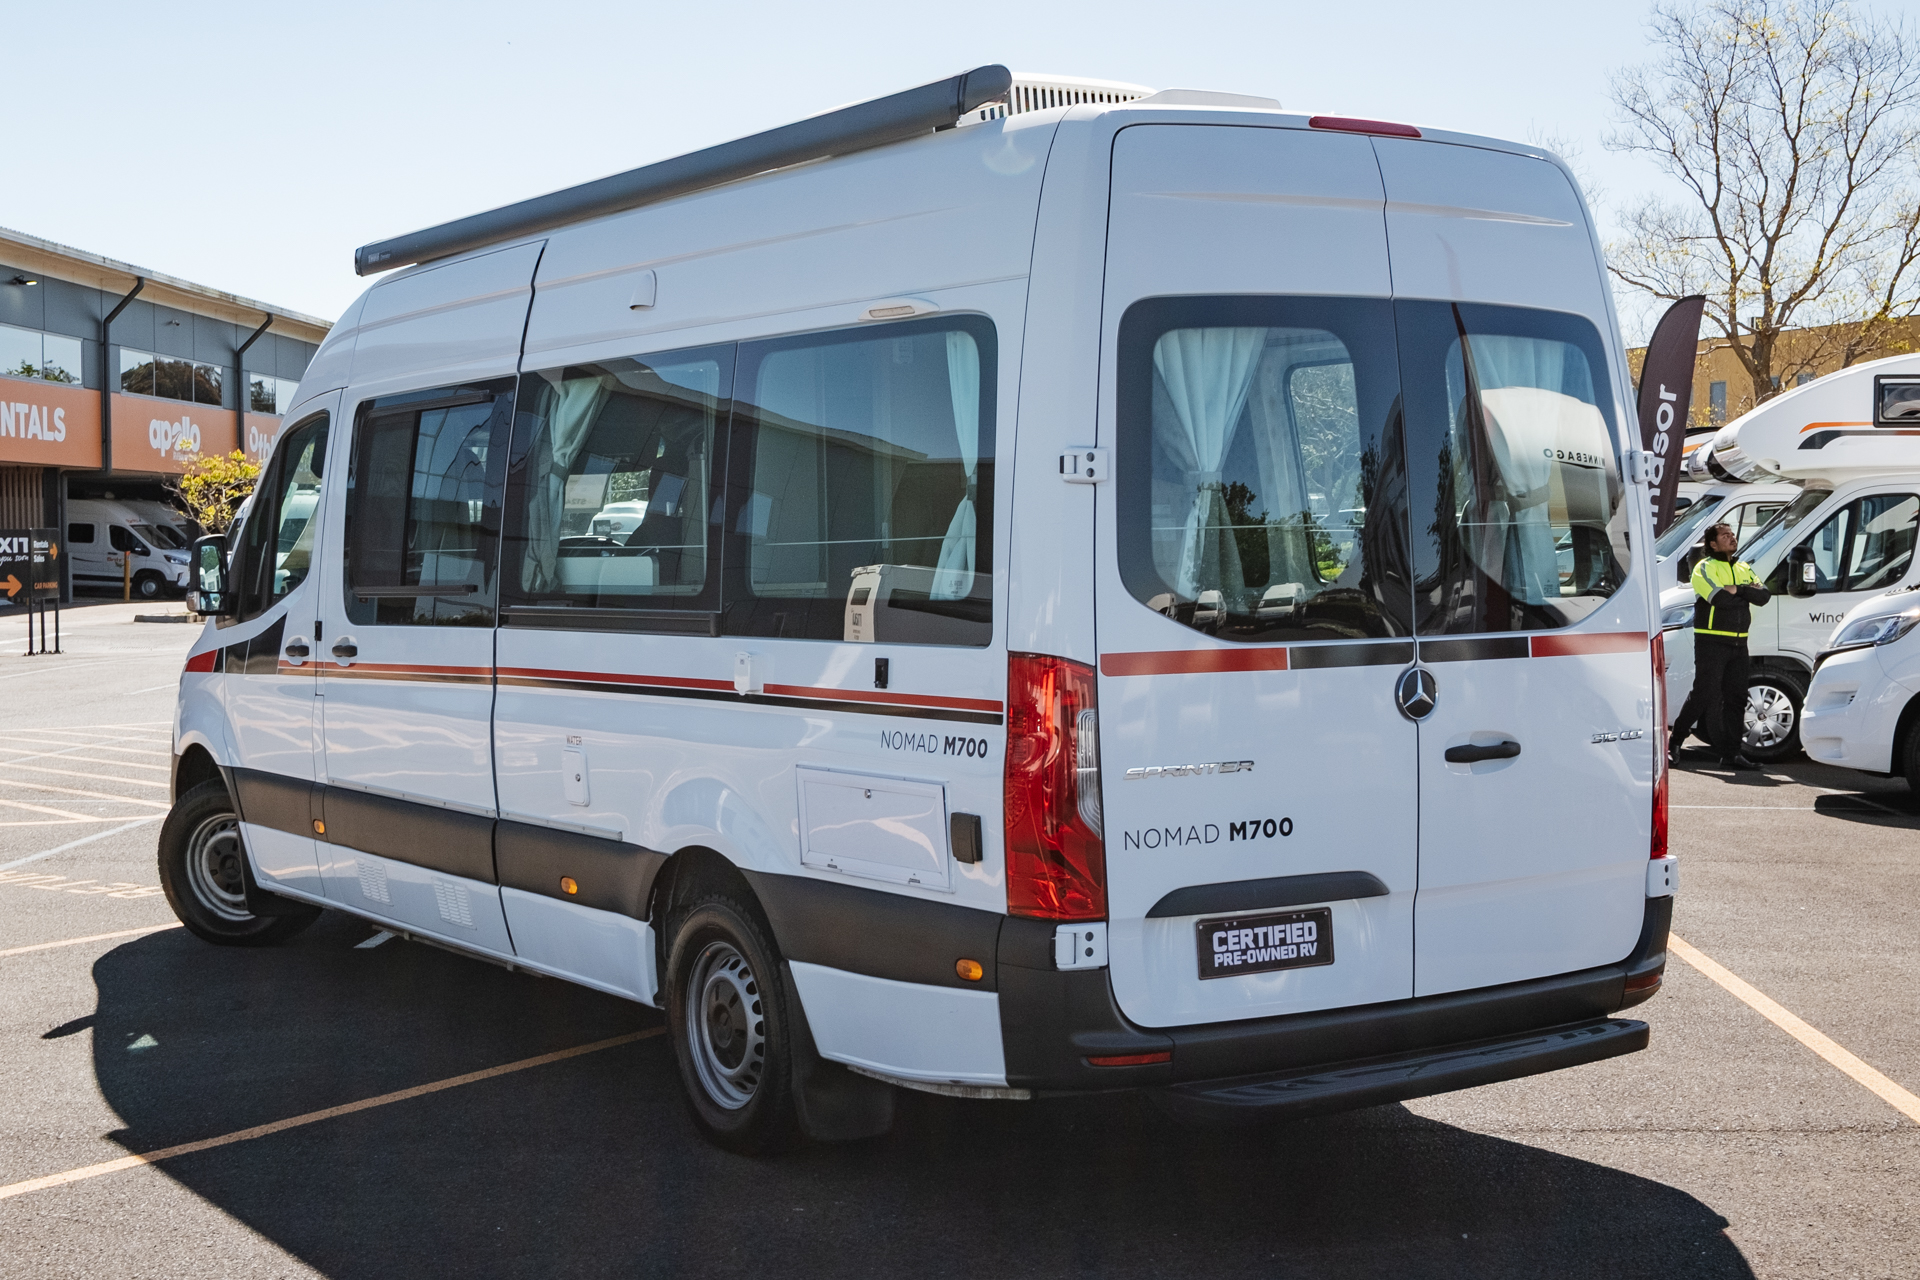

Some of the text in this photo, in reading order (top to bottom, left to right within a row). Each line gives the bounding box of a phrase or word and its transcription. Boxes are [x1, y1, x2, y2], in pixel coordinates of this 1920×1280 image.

[149, 416, 201, 458] apollo
[1808, 612, 1845, 624] Wind
[880, 730, 988, 759] NOMAD M700
[1123, 760, 1255, 781] SPRINTER
[1124, 817, 1294, 851] NOMAD M700
[1212, 920, 1318, 953] CERTIFIED
[1213, 941, 1318, 968] PRE-OWNED RV
